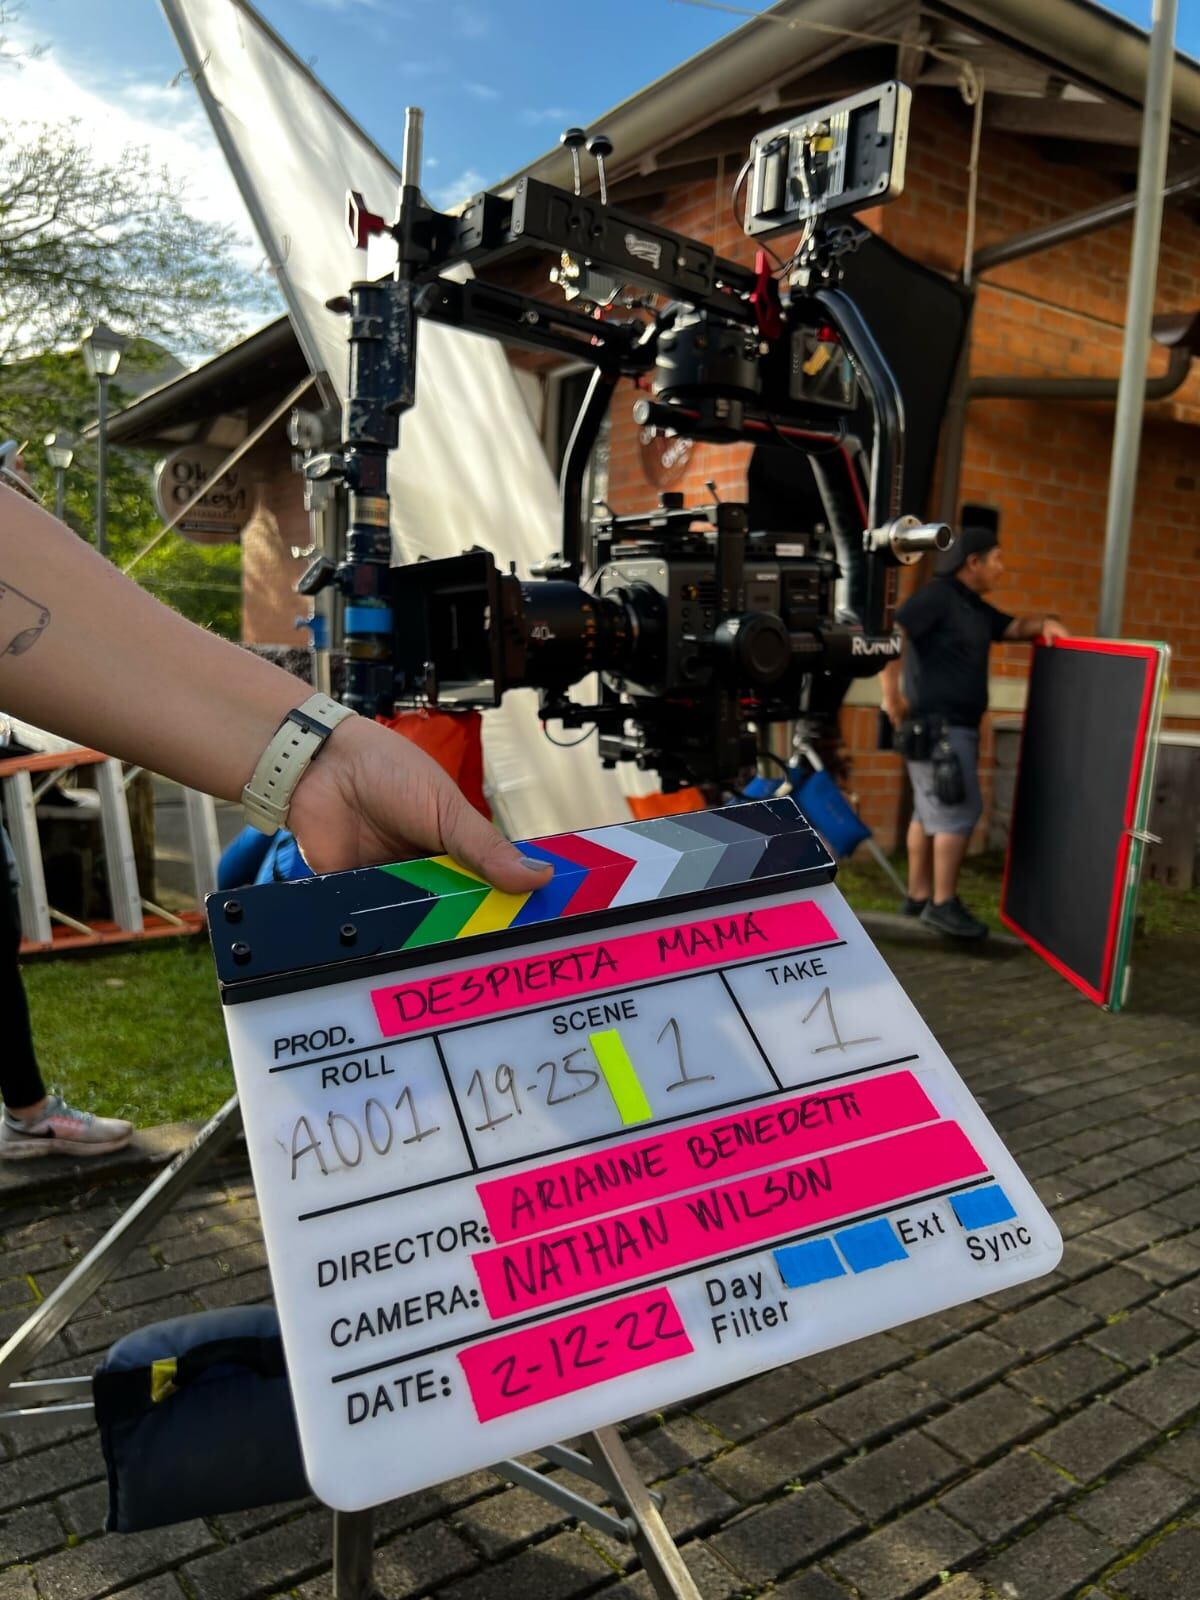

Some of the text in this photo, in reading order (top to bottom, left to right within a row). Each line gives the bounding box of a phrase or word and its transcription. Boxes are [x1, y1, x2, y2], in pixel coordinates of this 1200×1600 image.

[172, 463, 240, 492] Oky
[392, 911, 769, 1023] DESPIERTA MAMÁ
[765, 958, 828, 986] TAKE
[273, 1025, 355, 1060] PROD.
[552, 999, 638, 1036] SCENE
[801, 986, 883, 1054] 1
[321, 1055, 396, 1089] ROLL
[656, 1017, 716, 1093] 1
[290, 1085, 441, 1181] A001
[510, 1143, 669, 1230] ARIANNE
[317, 1219, 492, 1289] DIRECTOR:
[502, 1156, 833, 1302] NATHAN WILSON
[897, 1211, 946, 1246] Ext
[966, 1226, 1033, 1263] Sync
[329, 1284, 482, 1348] CAMERA:
[705, 1271, 762, 1307] Day
[491, 1301, 688, 1398] 2-12-22
[710, 1300, 789, 1345] Filter
[346, 1368, 453, 1426] DATE:
